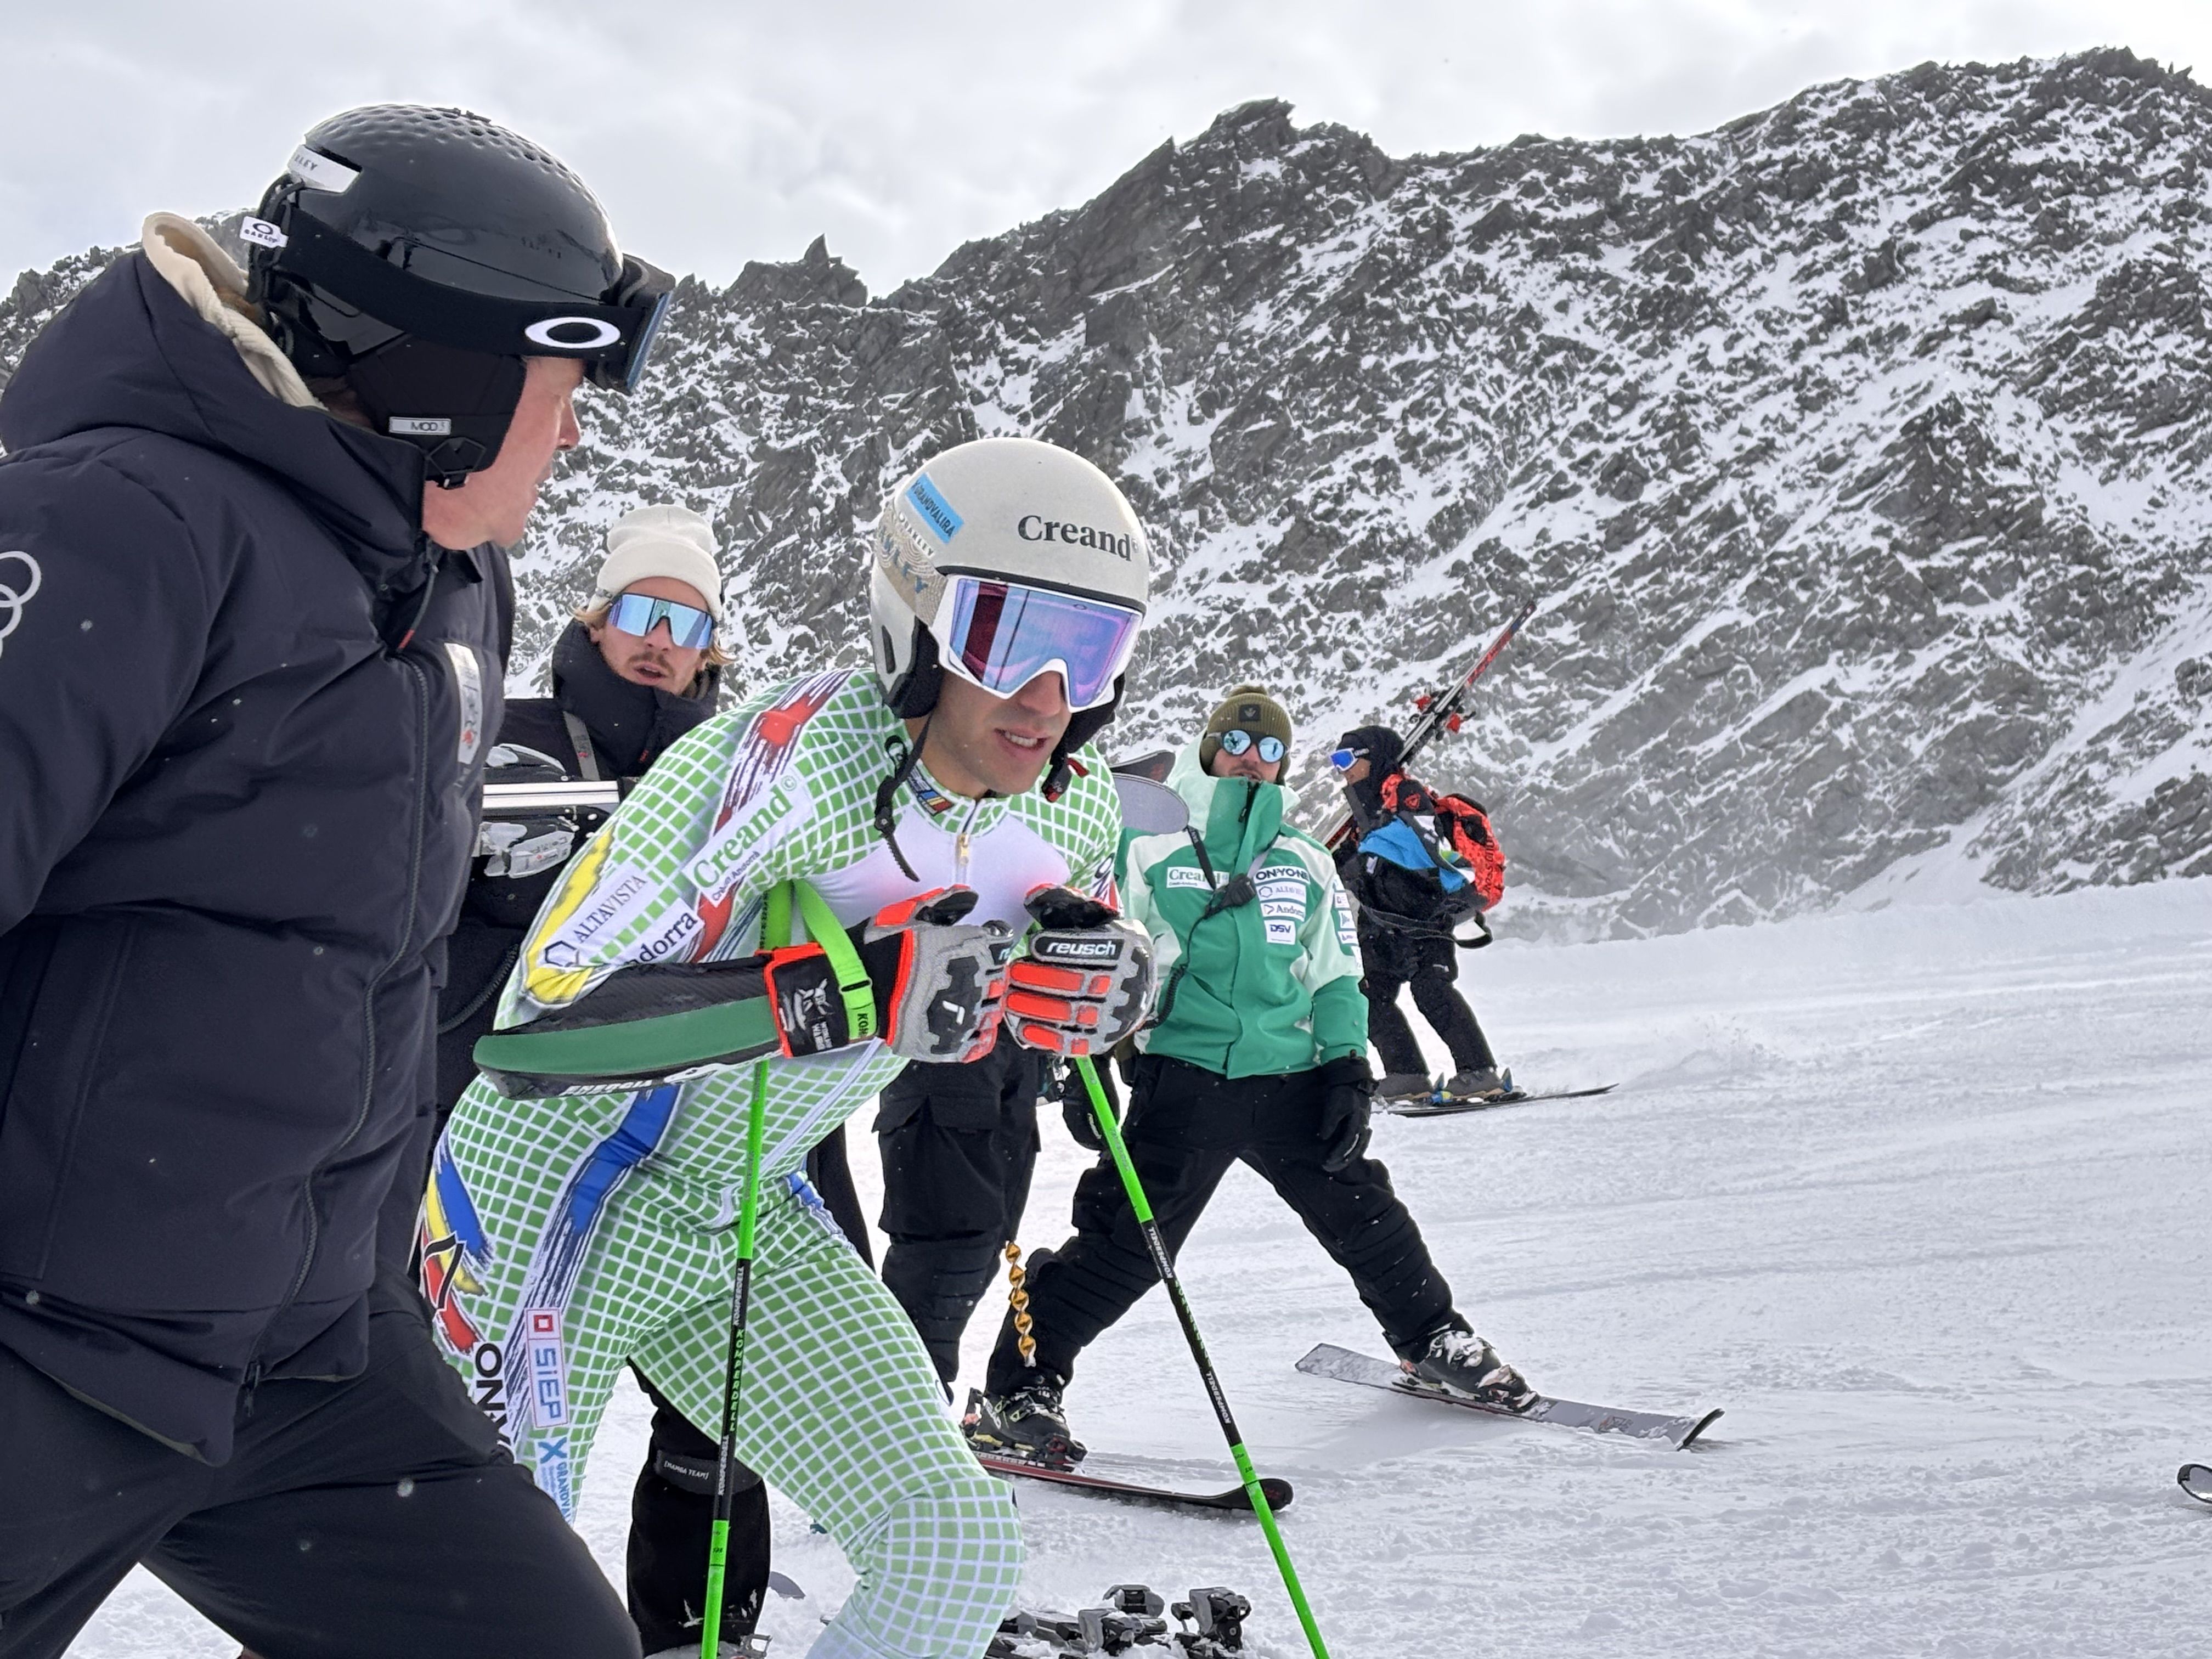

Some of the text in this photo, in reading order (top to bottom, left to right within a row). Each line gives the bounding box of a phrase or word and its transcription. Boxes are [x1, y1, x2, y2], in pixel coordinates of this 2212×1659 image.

[1018, 515, 1132, 561] Creand
[693, 785, 794, 888] Creand
[573, 876, 648, 944] ALTAVISTA
[1047, 940, 1116, 956] reusch
[1148, 1227, 1173, 1279] KOMPERDELL
[733, 1266, 744, 1326] KOMPERDELL
[730, 1329, 745, 1432] KOMPERDELL
[1206, 1371, 1231, 1424] KOMPERDELL
